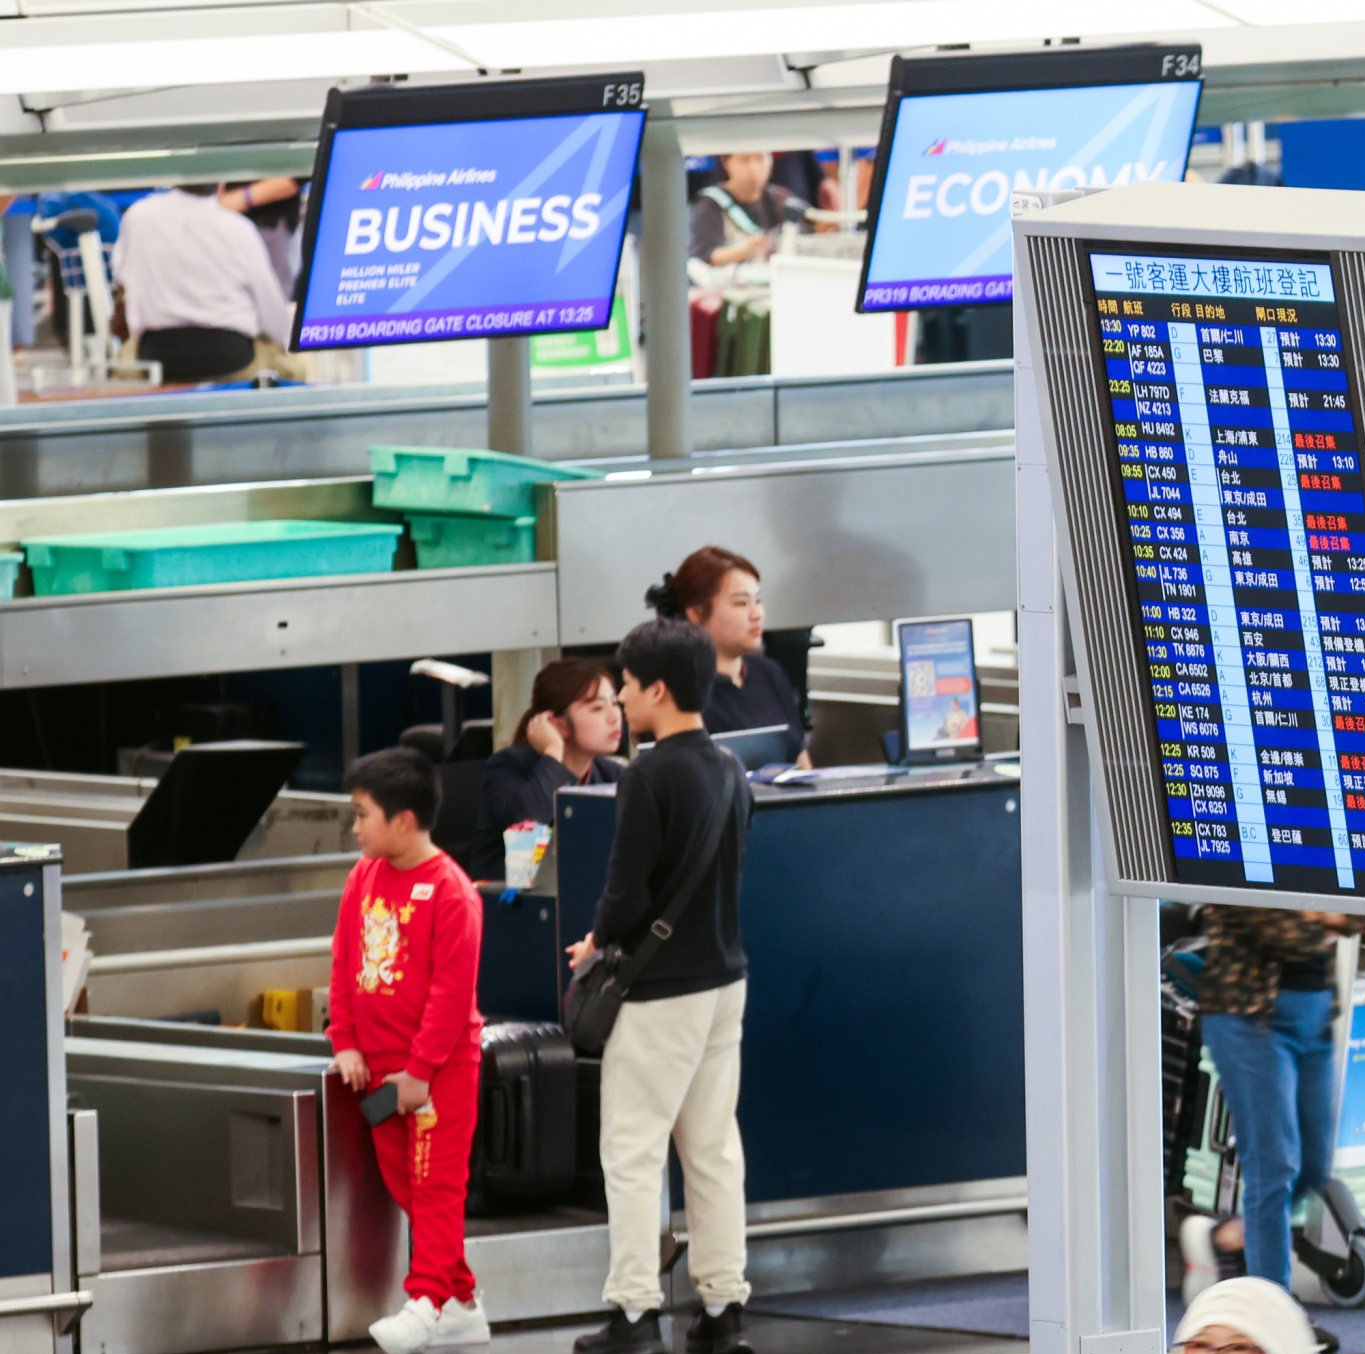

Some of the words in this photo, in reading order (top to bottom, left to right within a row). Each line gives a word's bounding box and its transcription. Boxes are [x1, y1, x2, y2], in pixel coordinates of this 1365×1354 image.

[1162, 55, 1199, 76] F34
[603, 84, 640, 106] F35
[947, 138, 1008, 157] Philippine
[1010, 136, 1057, 151] Airlines
[382, 170, 445, 191] Philippine
[449, 167, 497, 184] Airlines
[344, 193, 602, 255] BUSINESS
[341, 264, 384, 278] MILLION
[387, 262, 420, 275] MILER
[1106, 261, 1320, 297] 一號客運大樓航班登記
[338, 279, 386, 292] PREMIER
[388, 277, 417, 289] ELITE
[865, 286, 908, 305] PR319
[985, 281, 1012, 298] GAT
[336, 293, 366, 305] ELITE
[1098, 300, 1118, 314] 時間
[1124, 301, 1143, 316] 航班
[1171, 303, 1191, 318] 行段
[1196, 304, 1225, 319] 目的地
[300, 324, 345, 343] PR319
[348, 318, 420, 338] BOARDING
[425, 315, 463, 334] GATE
[466, 310, 532, 331] CLOSURE
[535, 309, 555, 324] AT
[559, 306, 594, 324] 13:25
[1101, 319, 1122, 331] 13:30
[1128, 324, 1139, 337] YP
[1141, 326, 1156, 338] 802
[1200, 328, 1244, 344] 首爾/仁川
[1279, 332, 1300, 347] 預計
[1314, 333, 1336, 347] 13:30
[1160, 744, 1181, 757] 12:25
[1187, 746, 1198, 758] KR
[1201, 747, 1215, 759] 508
